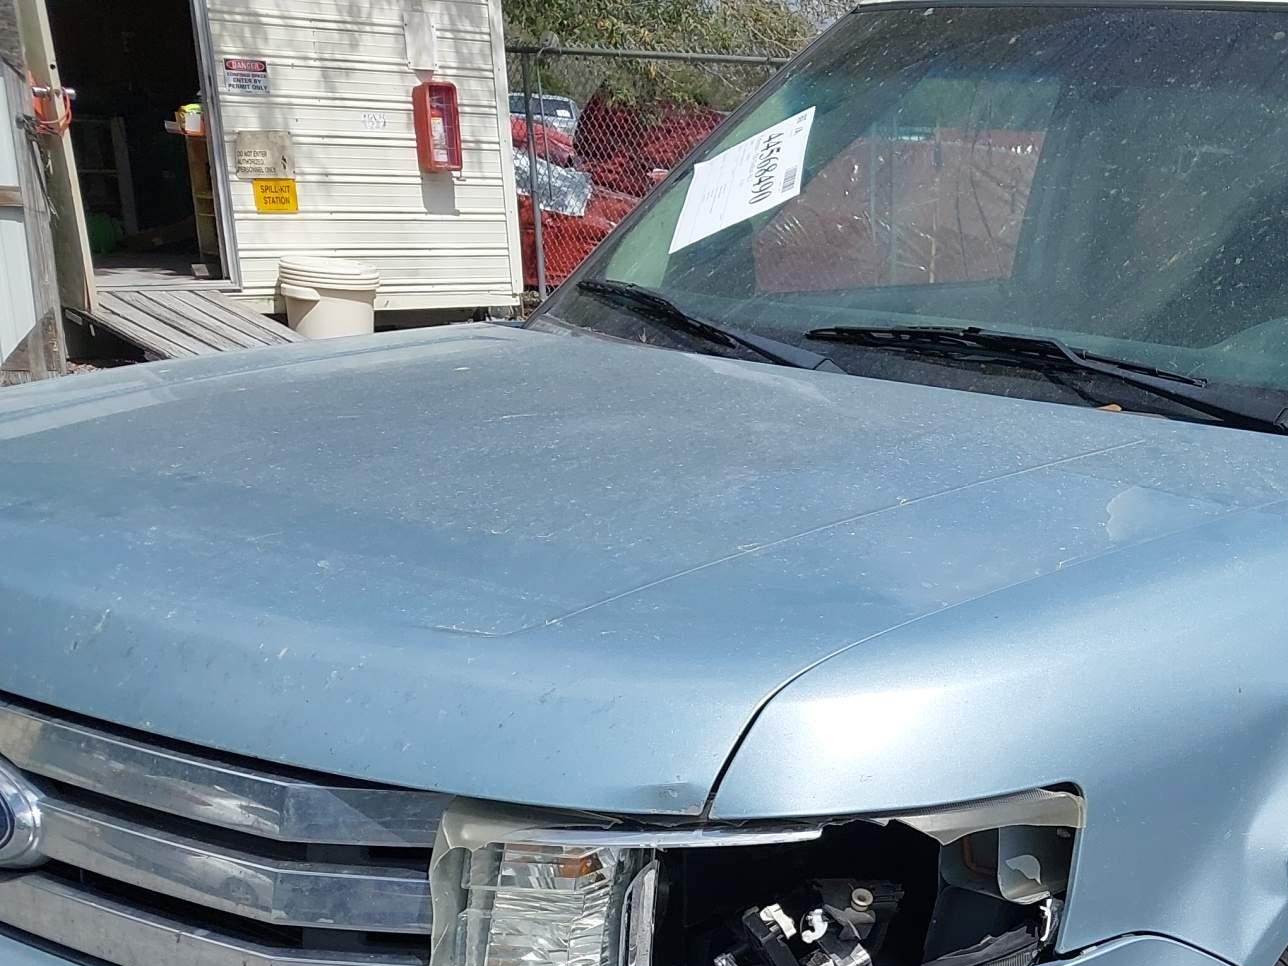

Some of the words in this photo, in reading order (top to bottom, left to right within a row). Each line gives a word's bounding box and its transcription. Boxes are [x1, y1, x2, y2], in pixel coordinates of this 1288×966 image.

[231, 61, 260, 70] DANGER
[748, 132, 784, 204] 44568490
[260, 185, 290, 193] SPILL-KIT
[263, 196, 290, 205] STATION
